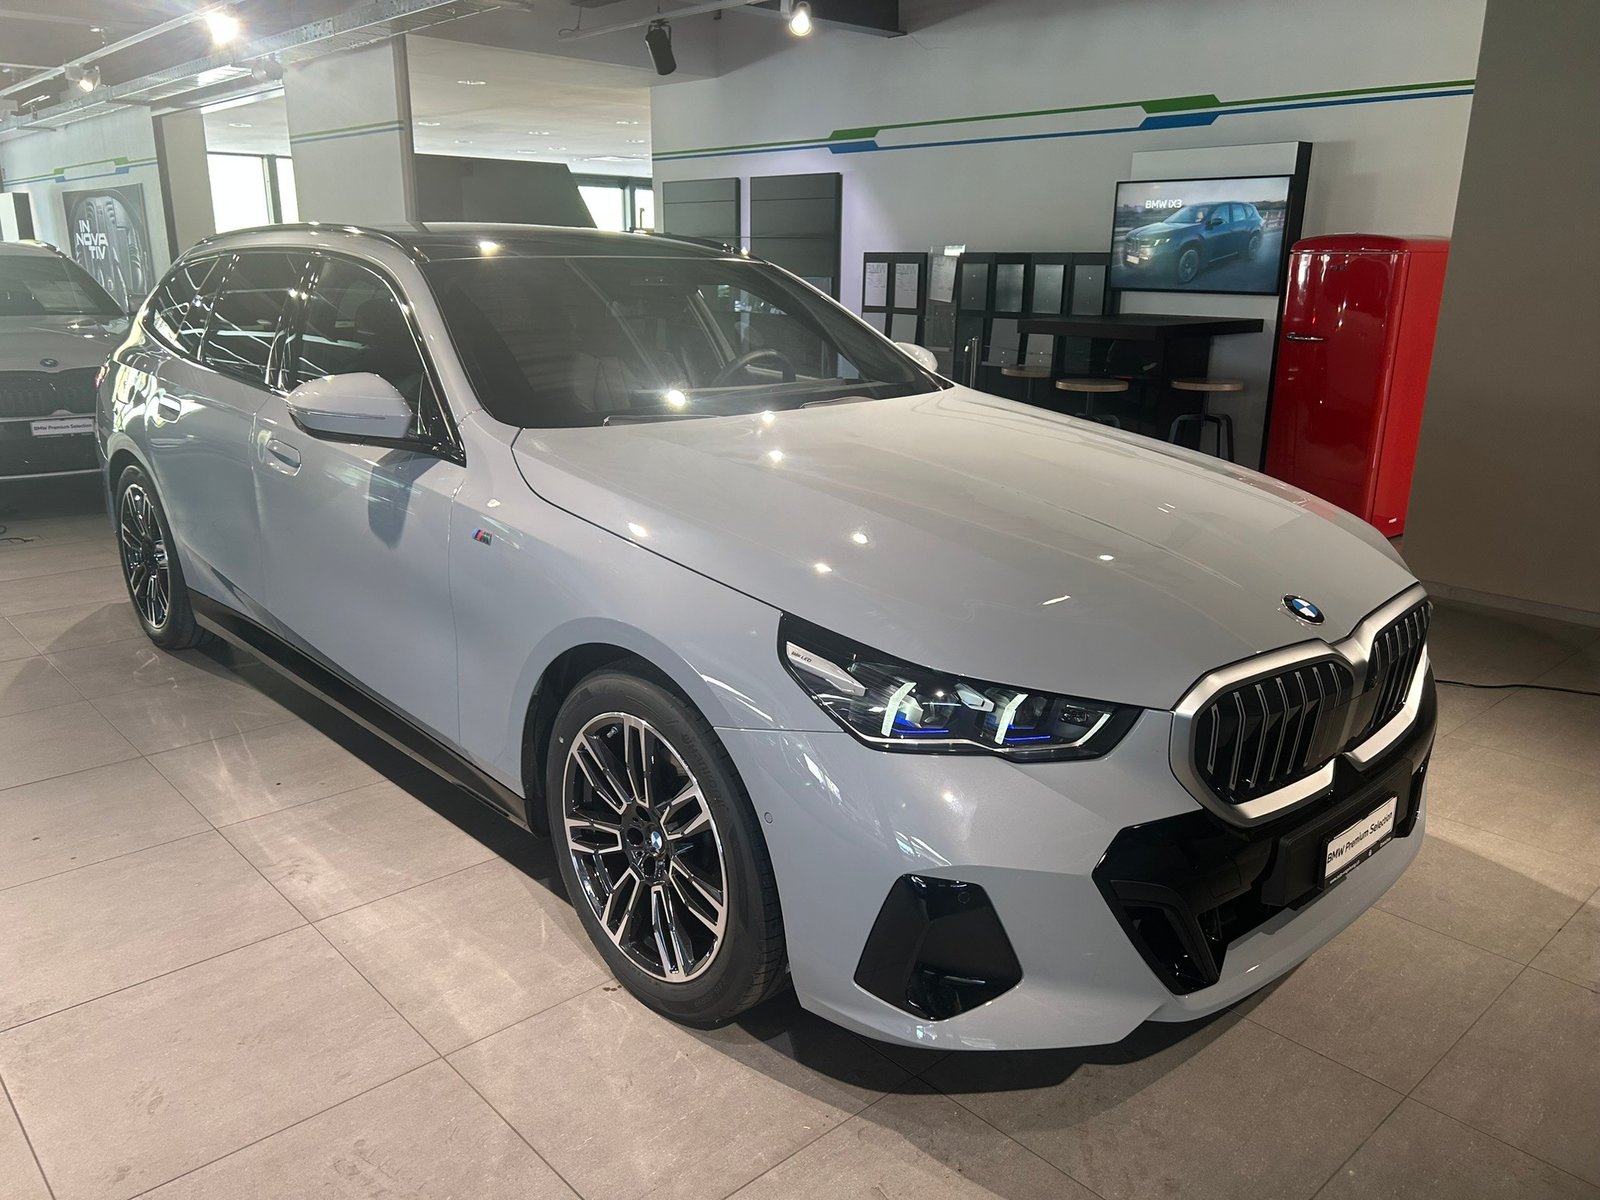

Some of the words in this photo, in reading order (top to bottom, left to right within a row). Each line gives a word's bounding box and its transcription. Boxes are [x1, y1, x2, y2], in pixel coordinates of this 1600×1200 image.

[1145, 200, 1167, 209] BMW
[78, 220, 91, 233] IN
[76, 232, 109, 247] NOVA
[89, 245, 106, 259] TIV
[800, 655, 812, 663] LED
[1327, 844, 1345, 864] BMW
[1345, 830, 1369, 852] Premium
[1369, 811, 1392, 834] Selection
